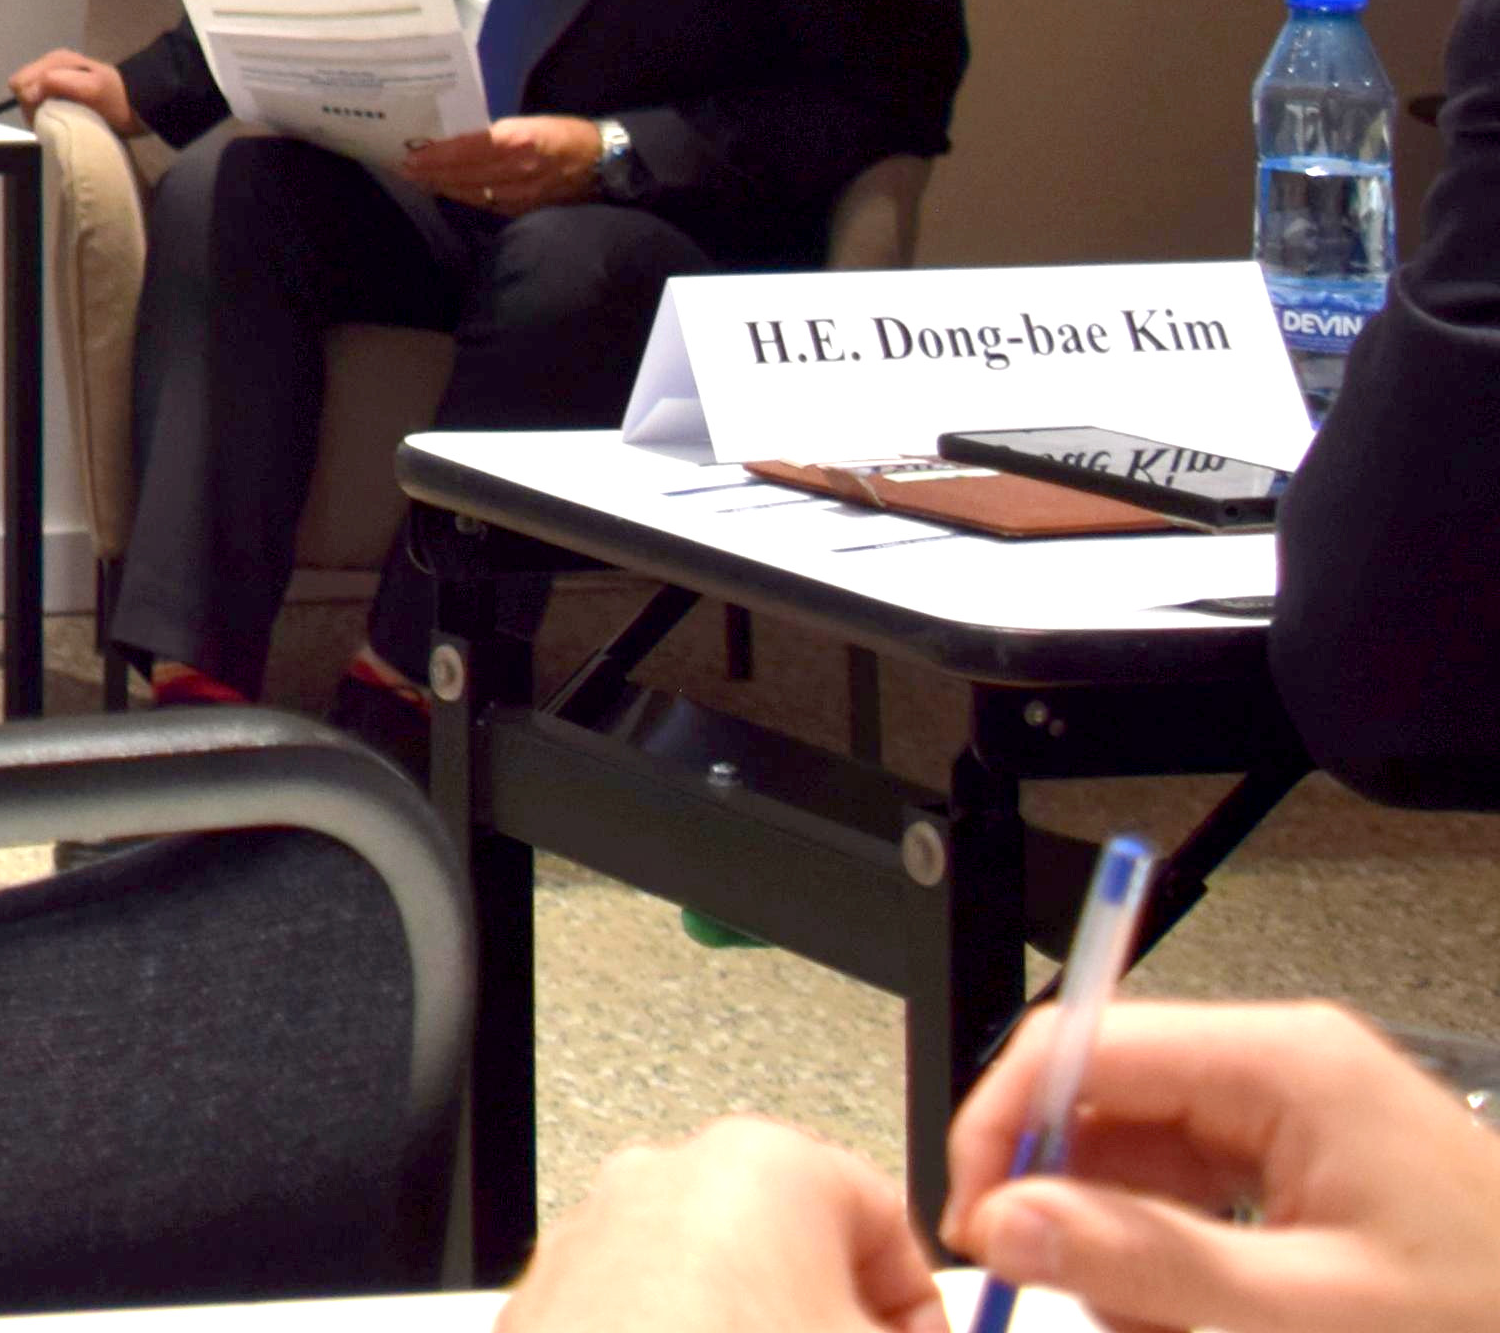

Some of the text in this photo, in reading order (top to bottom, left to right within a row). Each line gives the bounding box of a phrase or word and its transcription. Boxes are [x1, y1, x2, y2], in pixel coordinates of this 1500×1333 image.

[745, 307, 1232, 370] H.E. Dong-bae Kim
[1282, 309, 1363, 336] DEVIN
